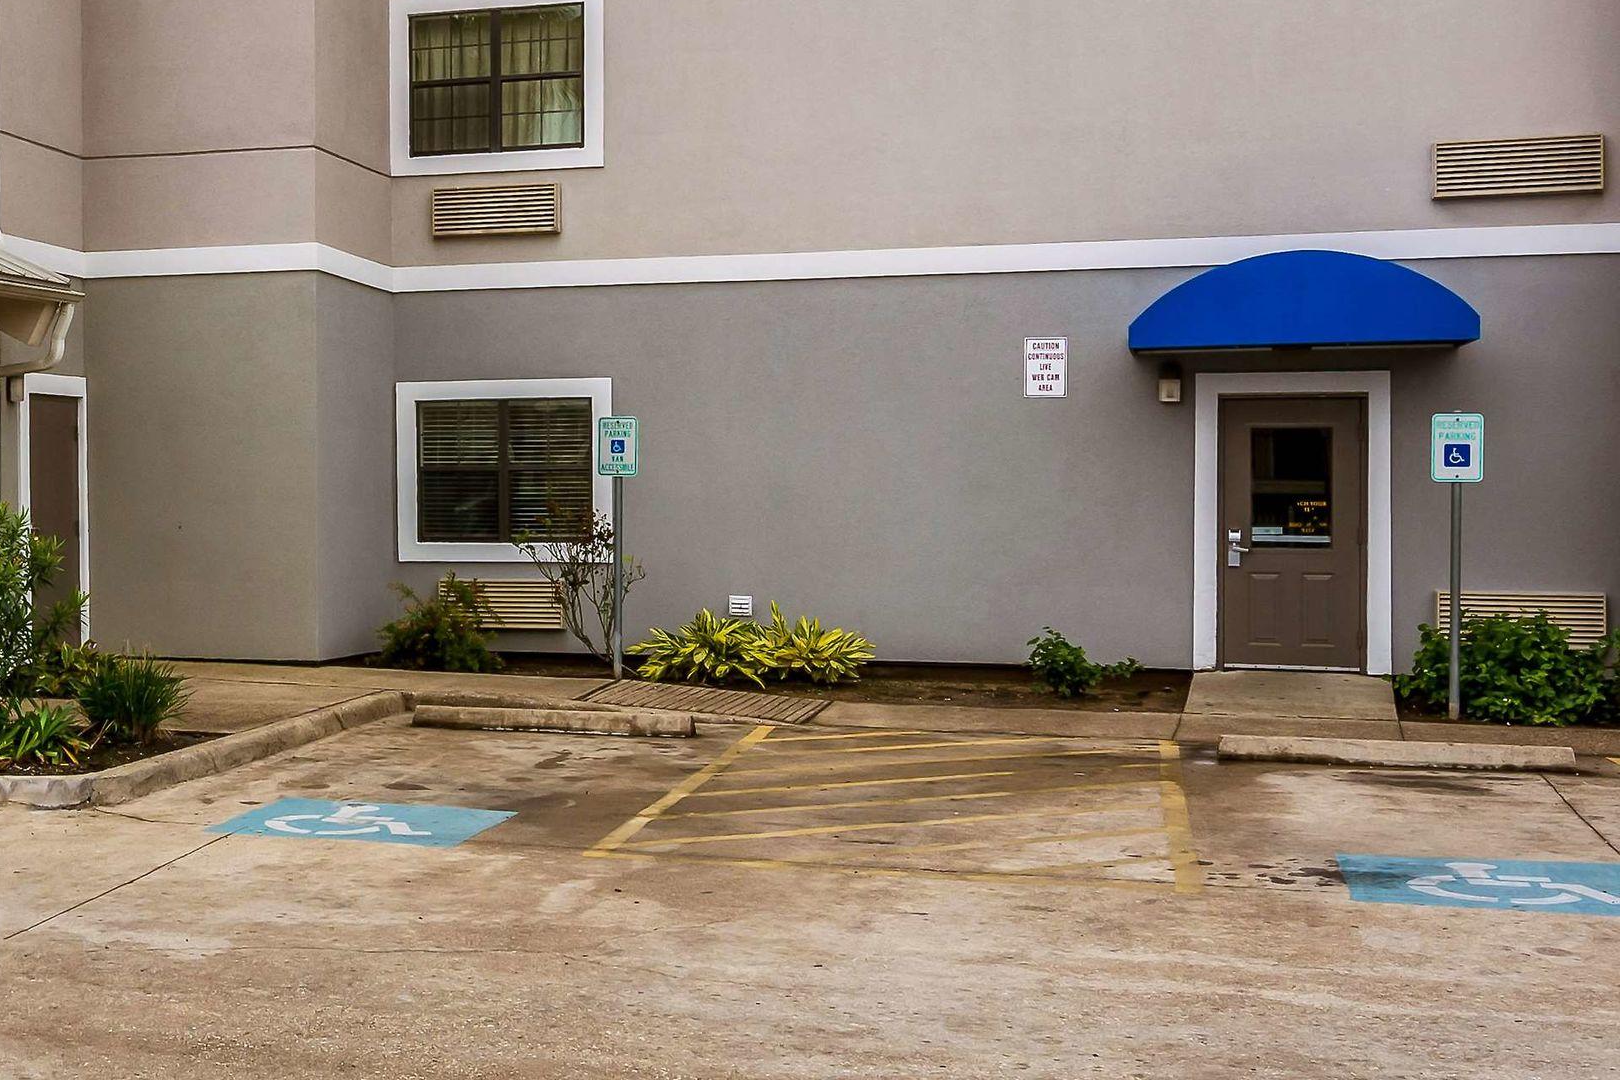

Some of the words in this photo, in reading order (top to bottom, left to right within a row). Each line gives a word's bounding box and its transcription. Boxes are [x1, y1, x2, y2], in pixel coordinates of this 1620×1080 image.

[1032, 342, 1060, 350] CAUTION
[1039, 363, 1052, 371] LIVE
[1032, 373, 1045, 381] WEB
[1046, 373, 1060, 381] CAM
[1438, 432, 1476, 440] PARKING
